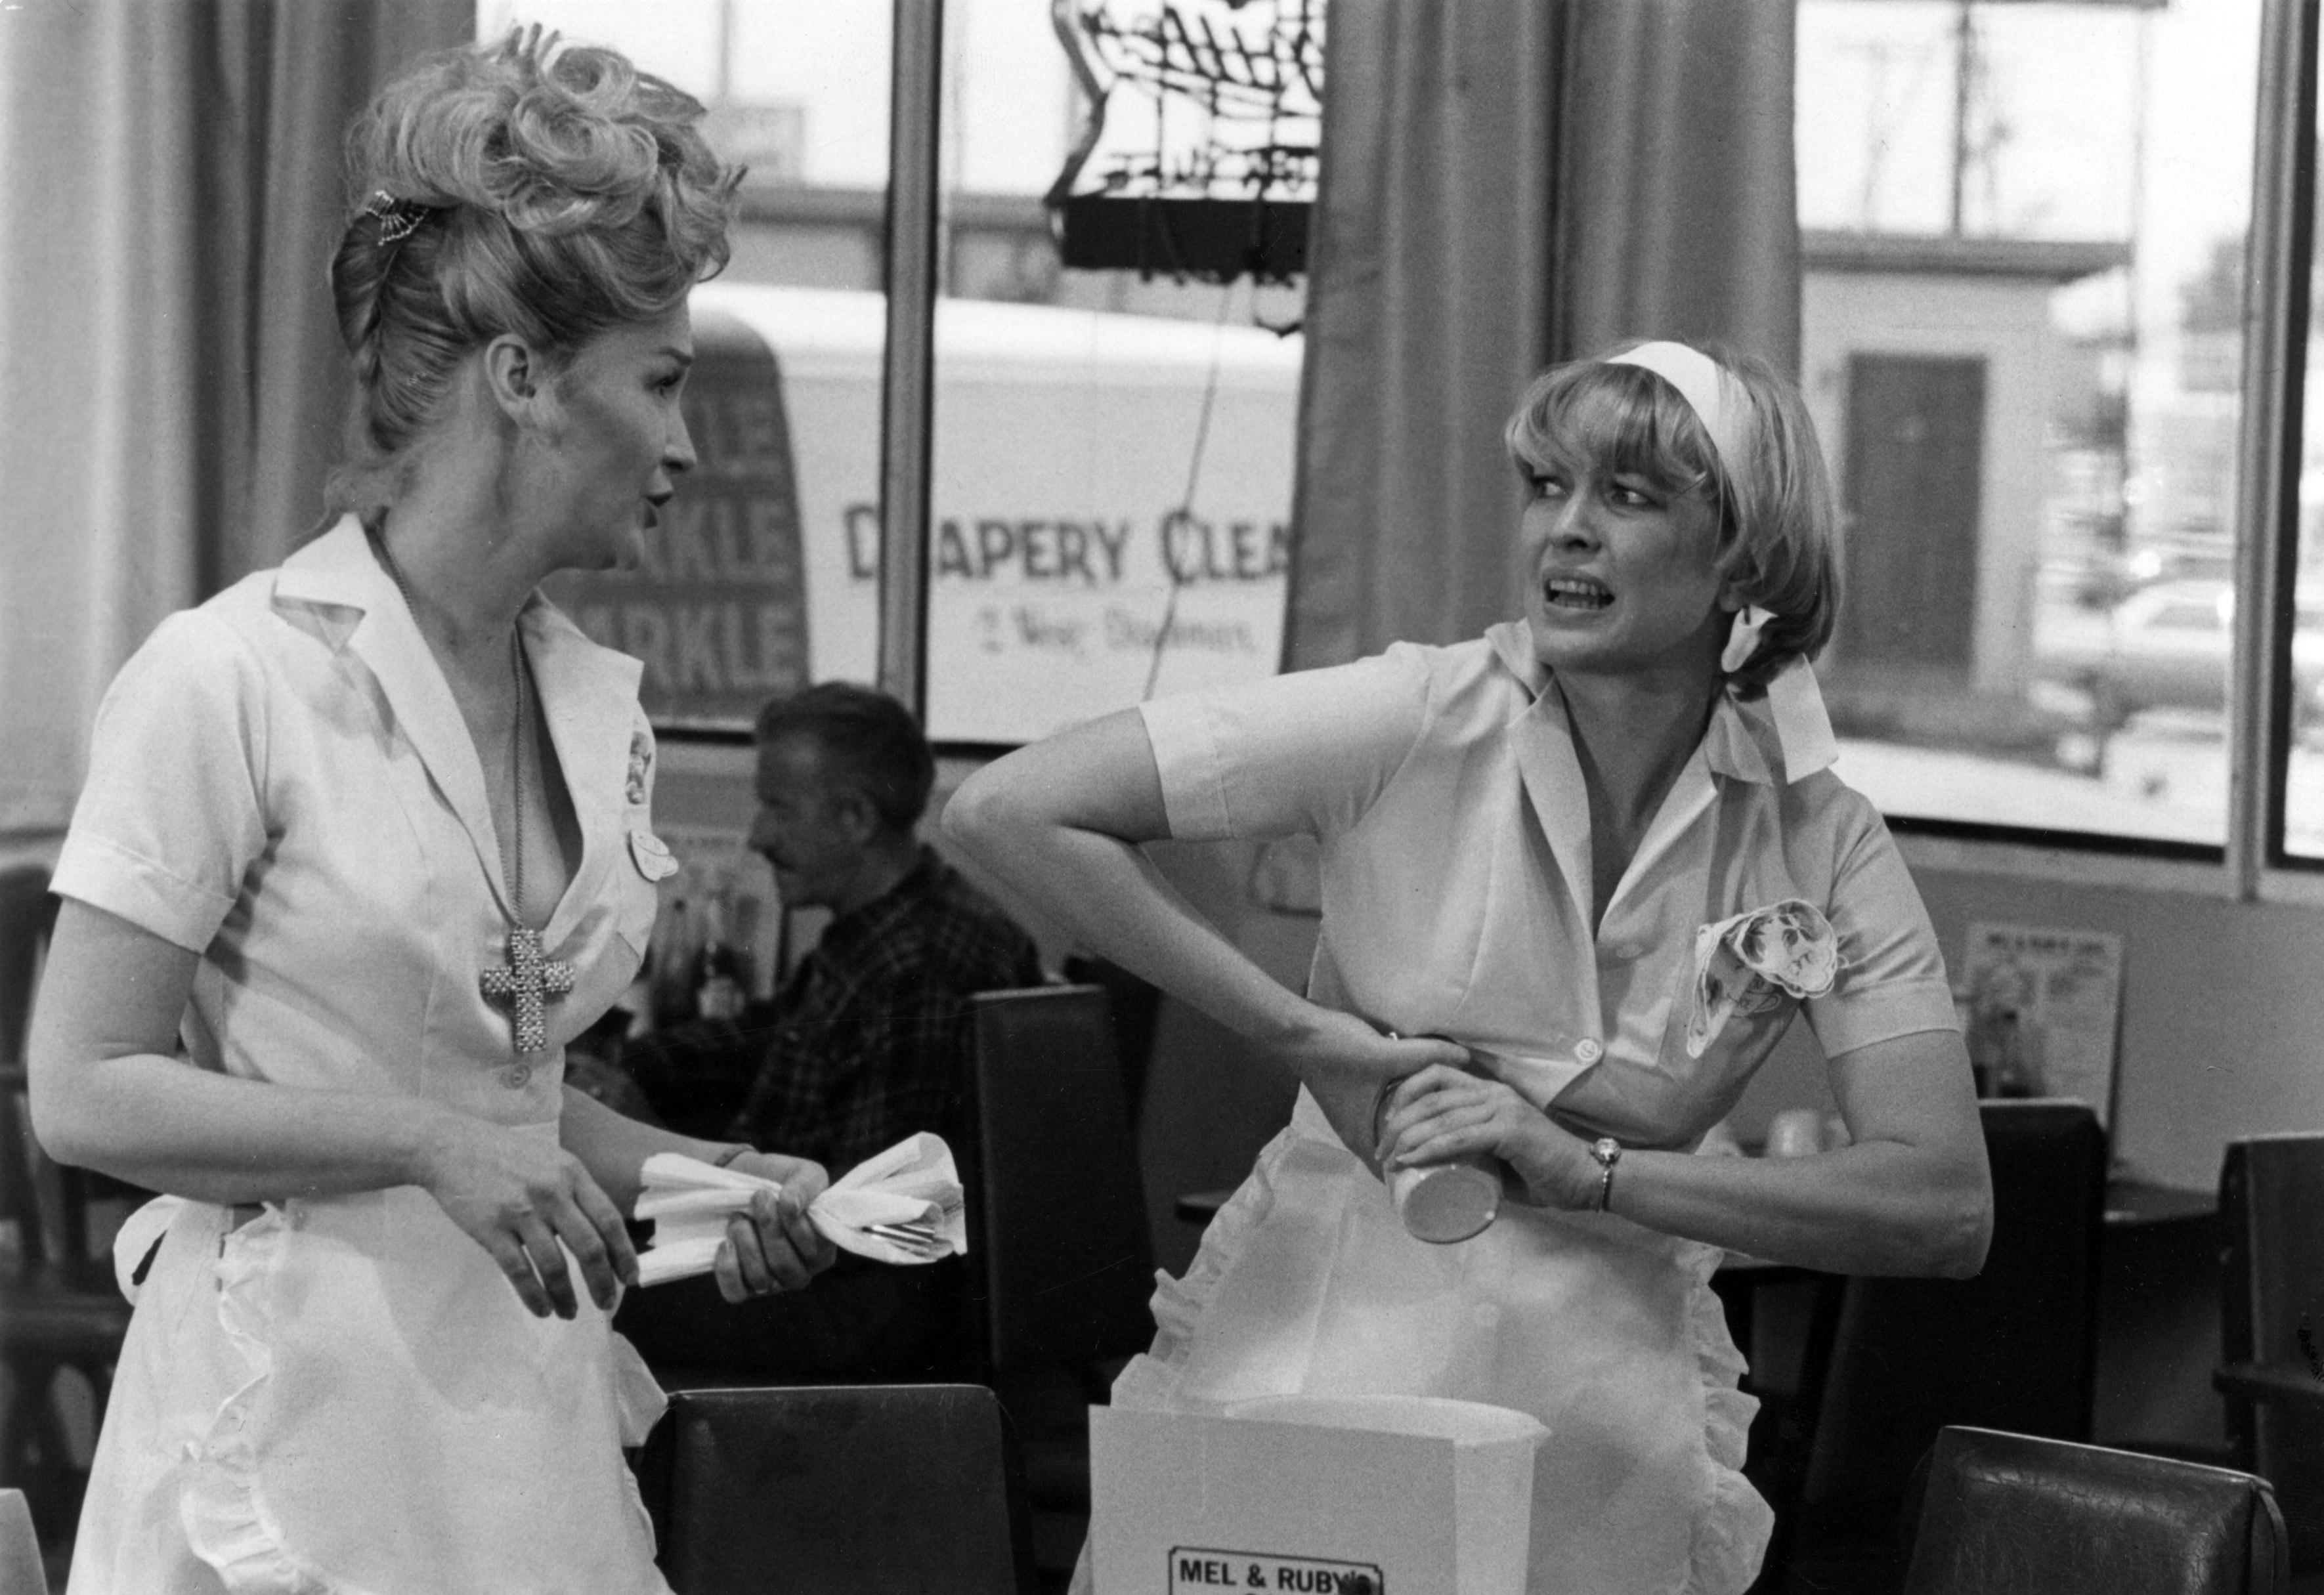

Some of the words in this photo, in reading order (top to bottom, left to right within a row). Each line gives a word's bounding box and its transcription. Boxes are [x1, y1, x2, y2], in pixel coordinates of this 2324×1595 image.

[843, 501, 1130, 588] DAPERY
[1180, 1558, 1237, 1586] MEL
[1246, 1563, 1267, 1589] &
